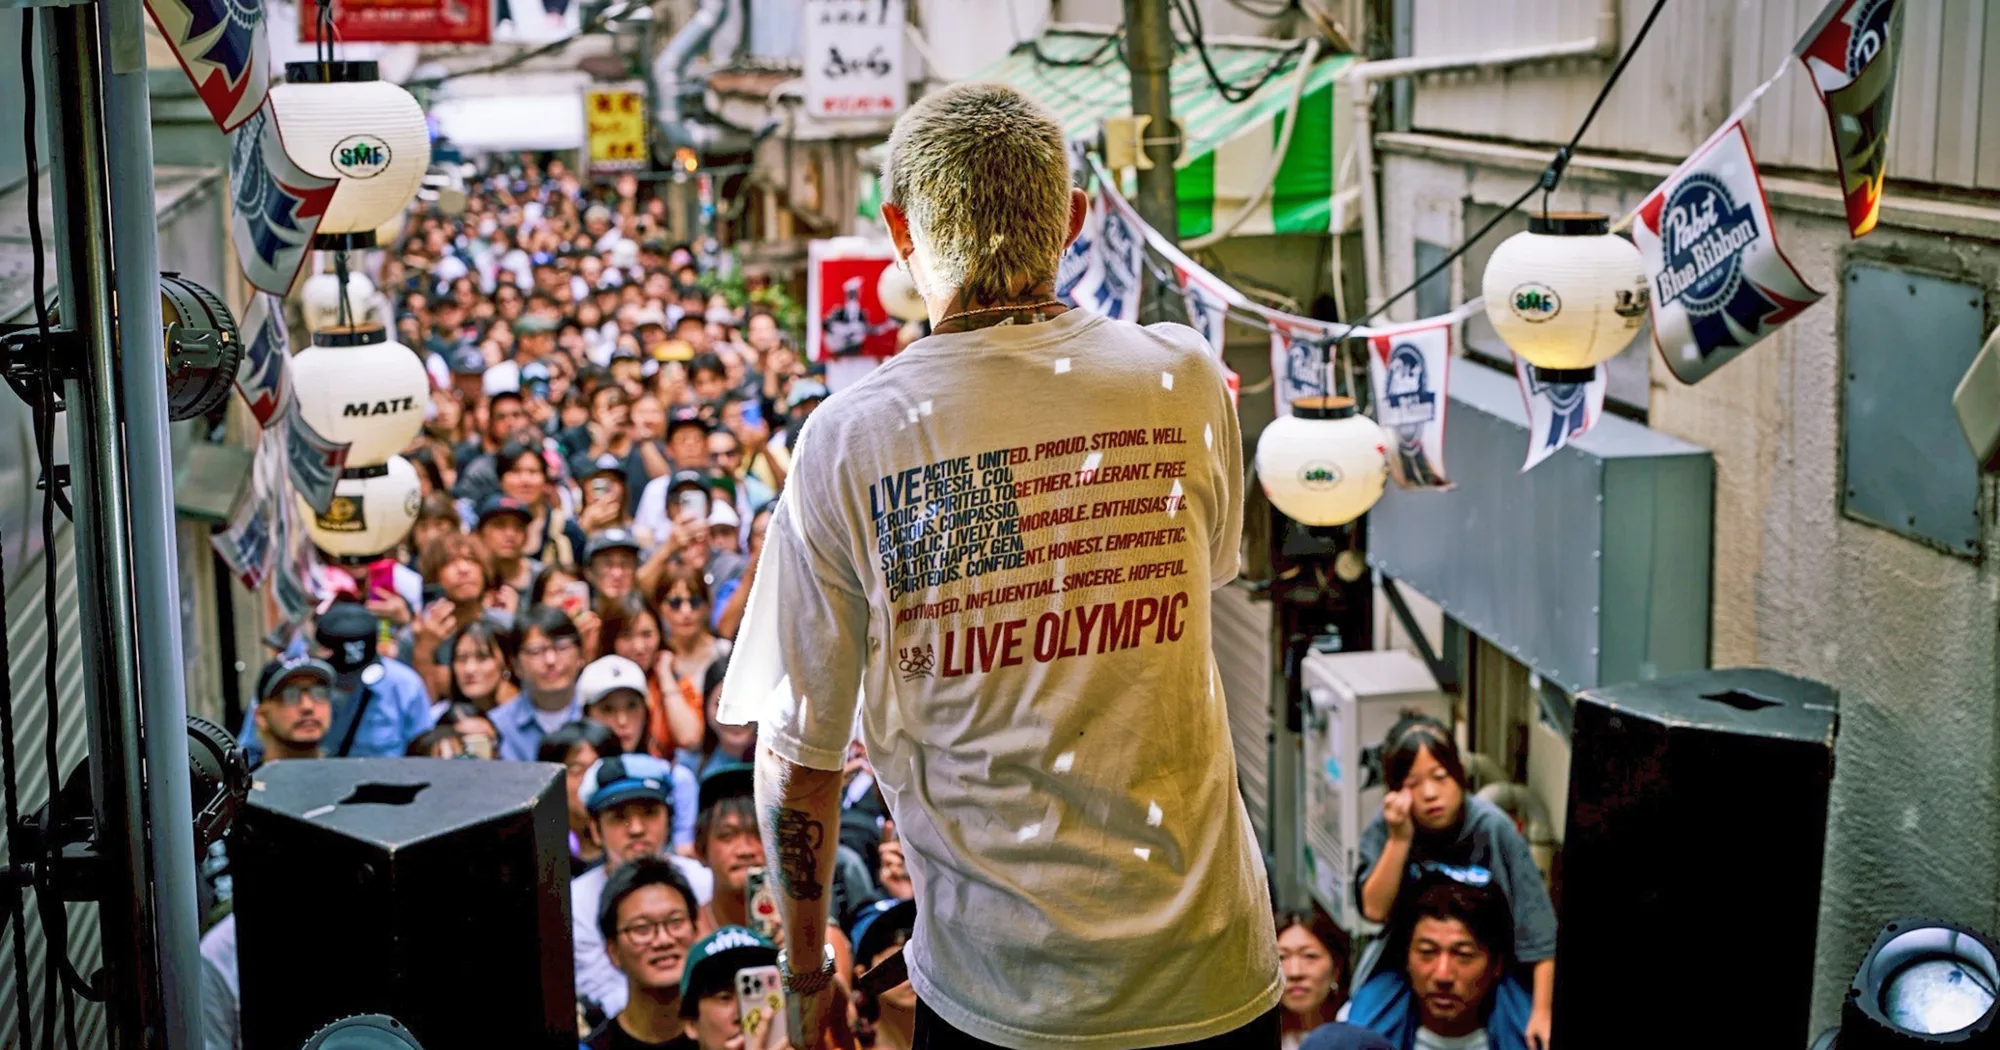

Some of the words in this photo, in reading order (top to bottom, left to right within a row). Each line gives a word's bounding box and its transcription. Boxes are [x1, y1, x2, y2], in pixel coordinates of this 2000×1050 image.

[340, 146, 383, 168] SMF
[1666, 190, 1719, 256] Pabst
[1659, 263, 1697, 303] Blue
[1692, 219, 1755, 277] Ribbon
[923, 456, 973, 483] ACTIVE.
[977, 446, 1031, 471] UNITED.
[1034, 436, 1088, 461] PROUD.
[1091, 429, 1149, 450] STRONG.
[1153, 428, 1187, 444] WELL.
[925, 473, 976, 500] FRESH.
[869, 467, 922, 521] LIVE
[876, 505, 922, 537] HEROIC.
[925, 488, 993, 518] SPIRITED.
[994, 471, 1073, 501] TOGETHER.
[1075, 463, 1150, 487] TOLERANT.
[1153, 461, 1187, 479] FREE.
[878, 518, 937, 554] GRACIOUS.
[881, 535, 945, 571] SYMBOLIC.
[947, 521, 994, 548] LIVELY.
[997, 505, 1090, 534] MEMORABLE.
[1092, 494, 1188, 519] ENTHUSIASTIC.
[886, 553, 937, 588] HEALTHY.
[940, 543, 987, 568] HAPPY.
[890, 565, 962, 602] COURTEOUS.
[966, 547, 1046, 577] CONFIDENT.
[1048, 537, 1103, 561] HONEST.
[1105, 527, 1187, 552] EMPATHETIC.
[895, 598, 962, 630] MOTIVATED.
[966, 578, 1060, 610] INFLUENTIAL.
[1062, 567, 1125, 592] SINCERE.
[942, 619, 1027, 677] LIVE
[1033, 591, 1189, 663] OLYMPIC
